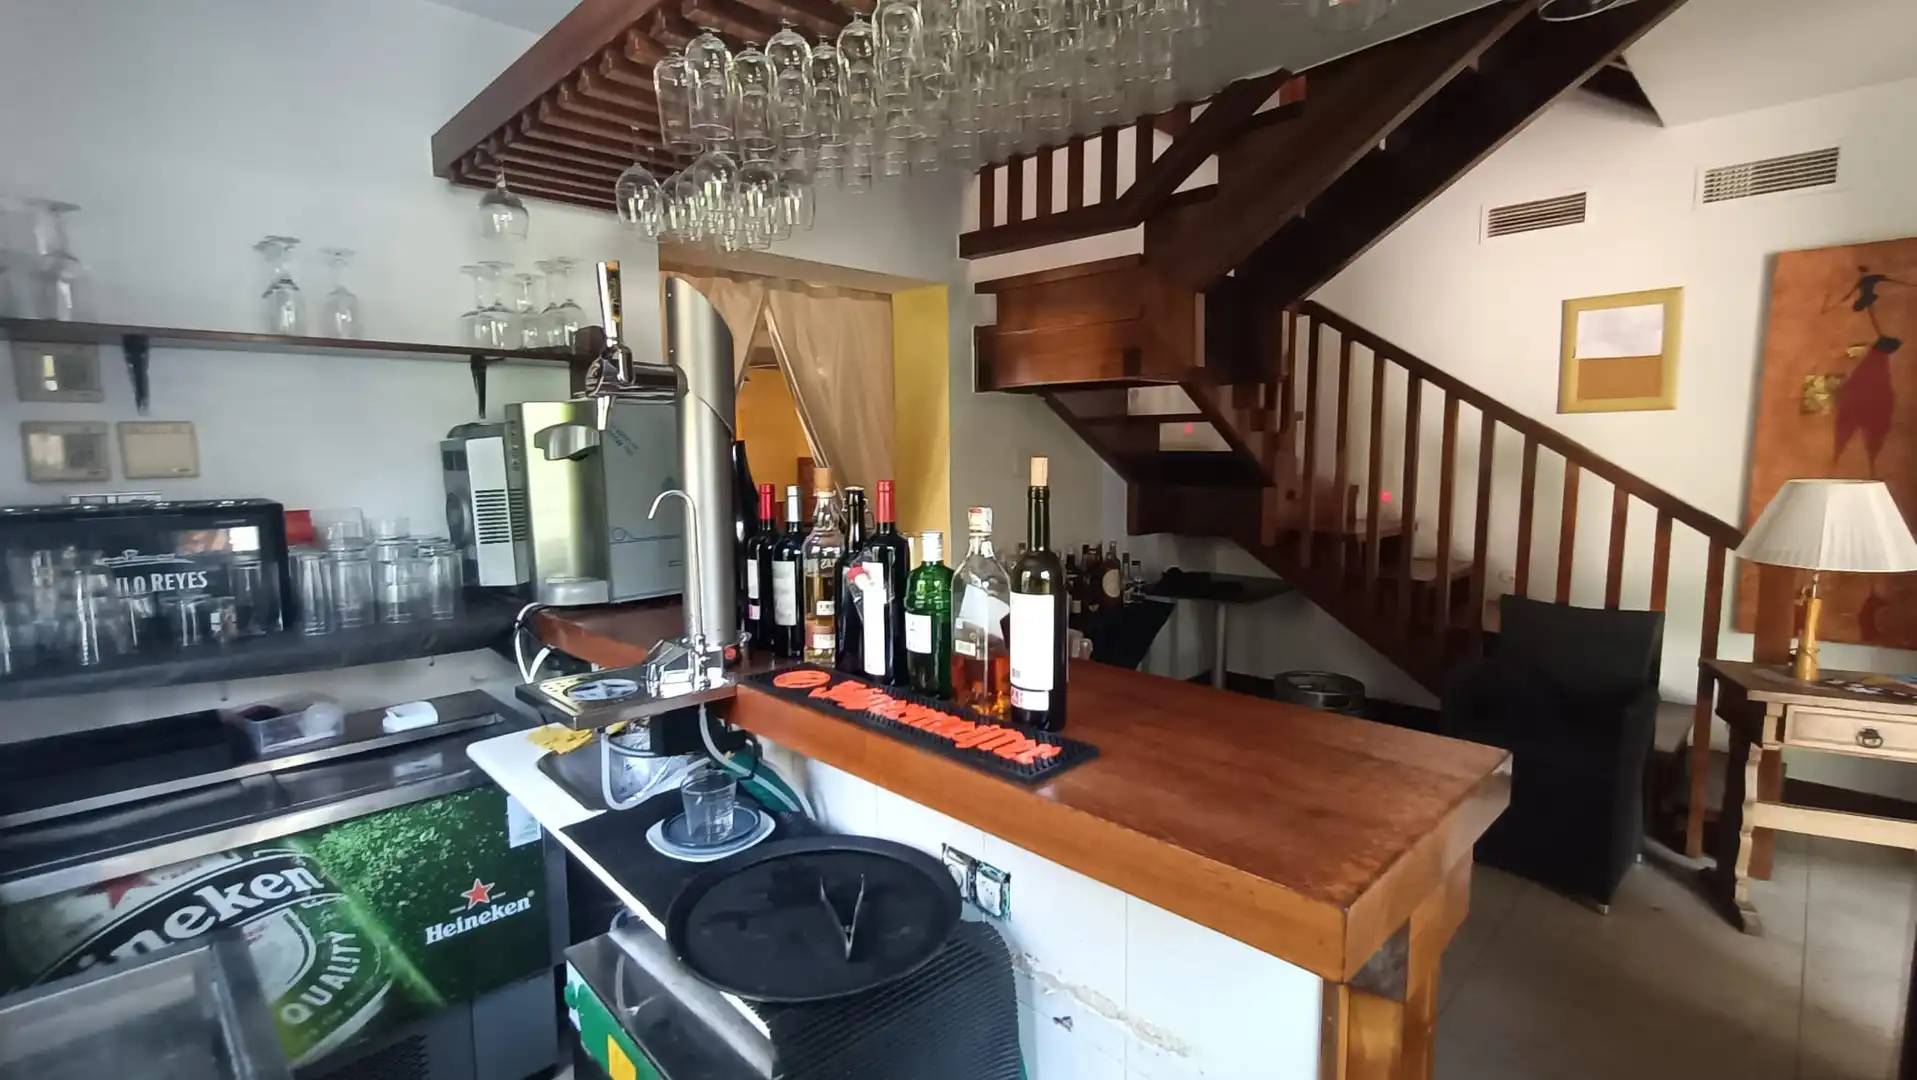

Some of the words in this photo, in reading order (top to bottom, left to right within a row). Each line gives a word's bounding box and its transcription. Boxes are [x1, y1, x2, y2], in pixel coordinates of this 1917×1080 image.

[151, 571, 208, 592] REYES
[425, 896, 532, 945] Heineken
[280, 931, 362, 1026] QUALITY
